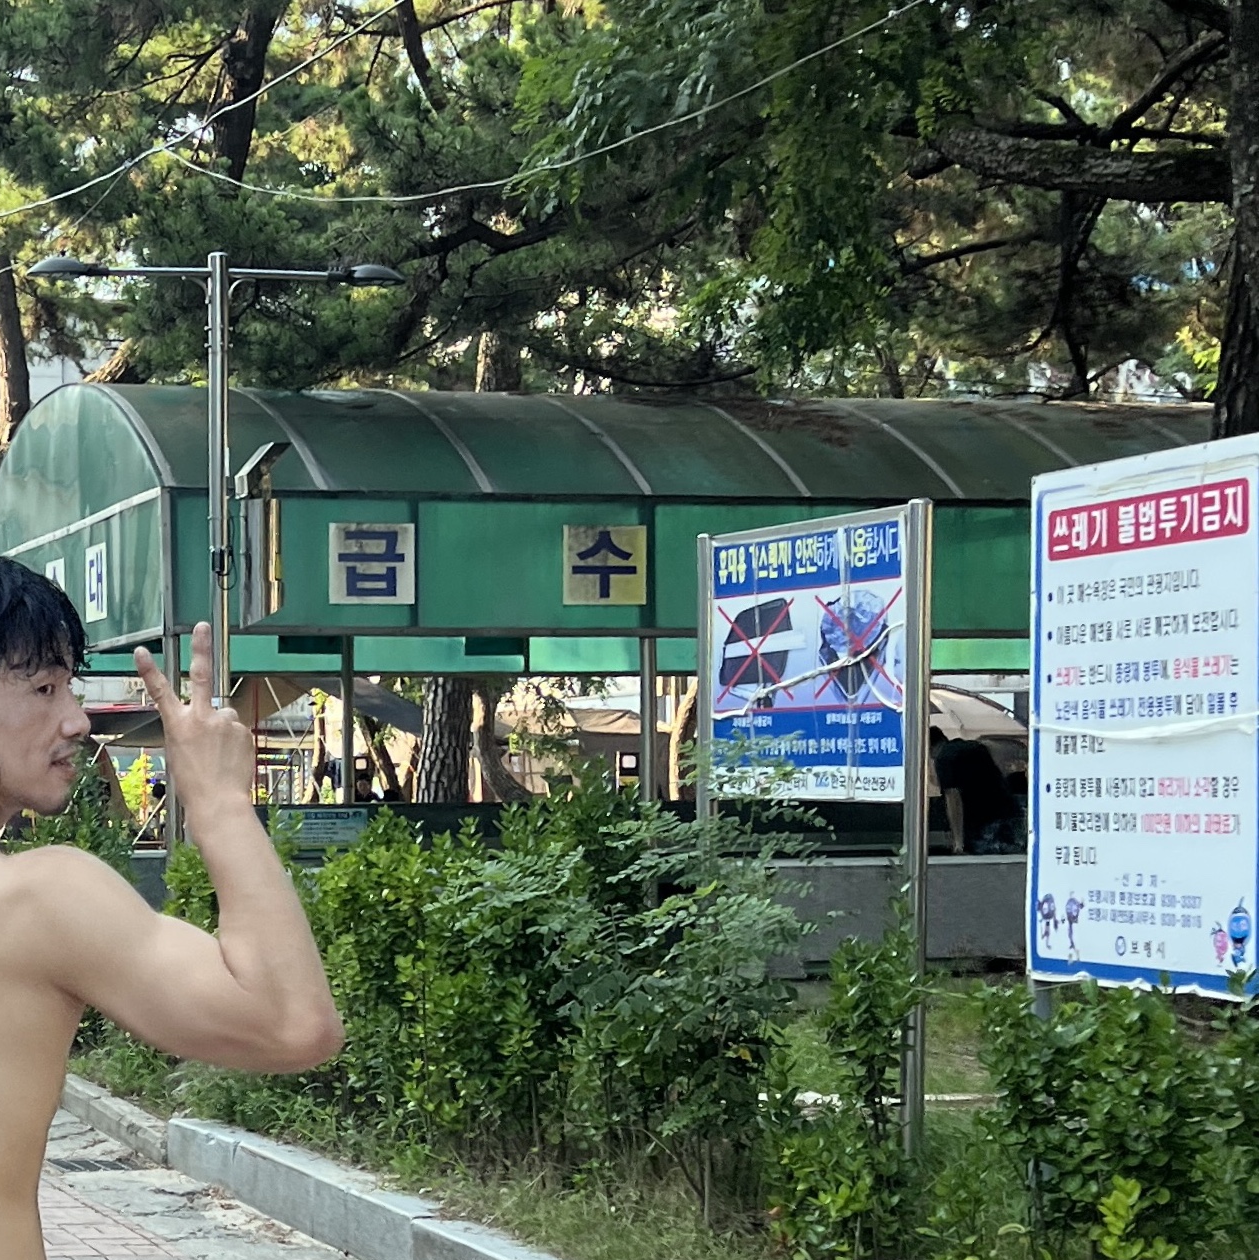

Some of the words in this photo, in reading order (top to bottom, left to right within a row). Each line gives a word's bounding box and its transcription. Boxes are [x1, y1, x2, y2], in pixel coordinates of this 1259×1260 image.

[1052, 508, 1108, 552] 쓰레기
[1117, 485, 1243, 545] 불법투기금지
[88, 549, 104, 614] 대
[337, 530, 405, 598] 급
[571, 530, 639, 598] 수
[718, 545, 747, 585] 휴대용
[1056, 665, 1087, 686] 쓰레기는
[1089, 663, 1113, 685] 반드시
[1173, 656, 1199, 680] 음식물
[1203, 654, 1240, 677] 쓰레기는
[1082, 698, 1106, 720] 음식물
[1109, 697, 1135, 719] 쓰레기
[1055, 846, 1070, 866] 부과
